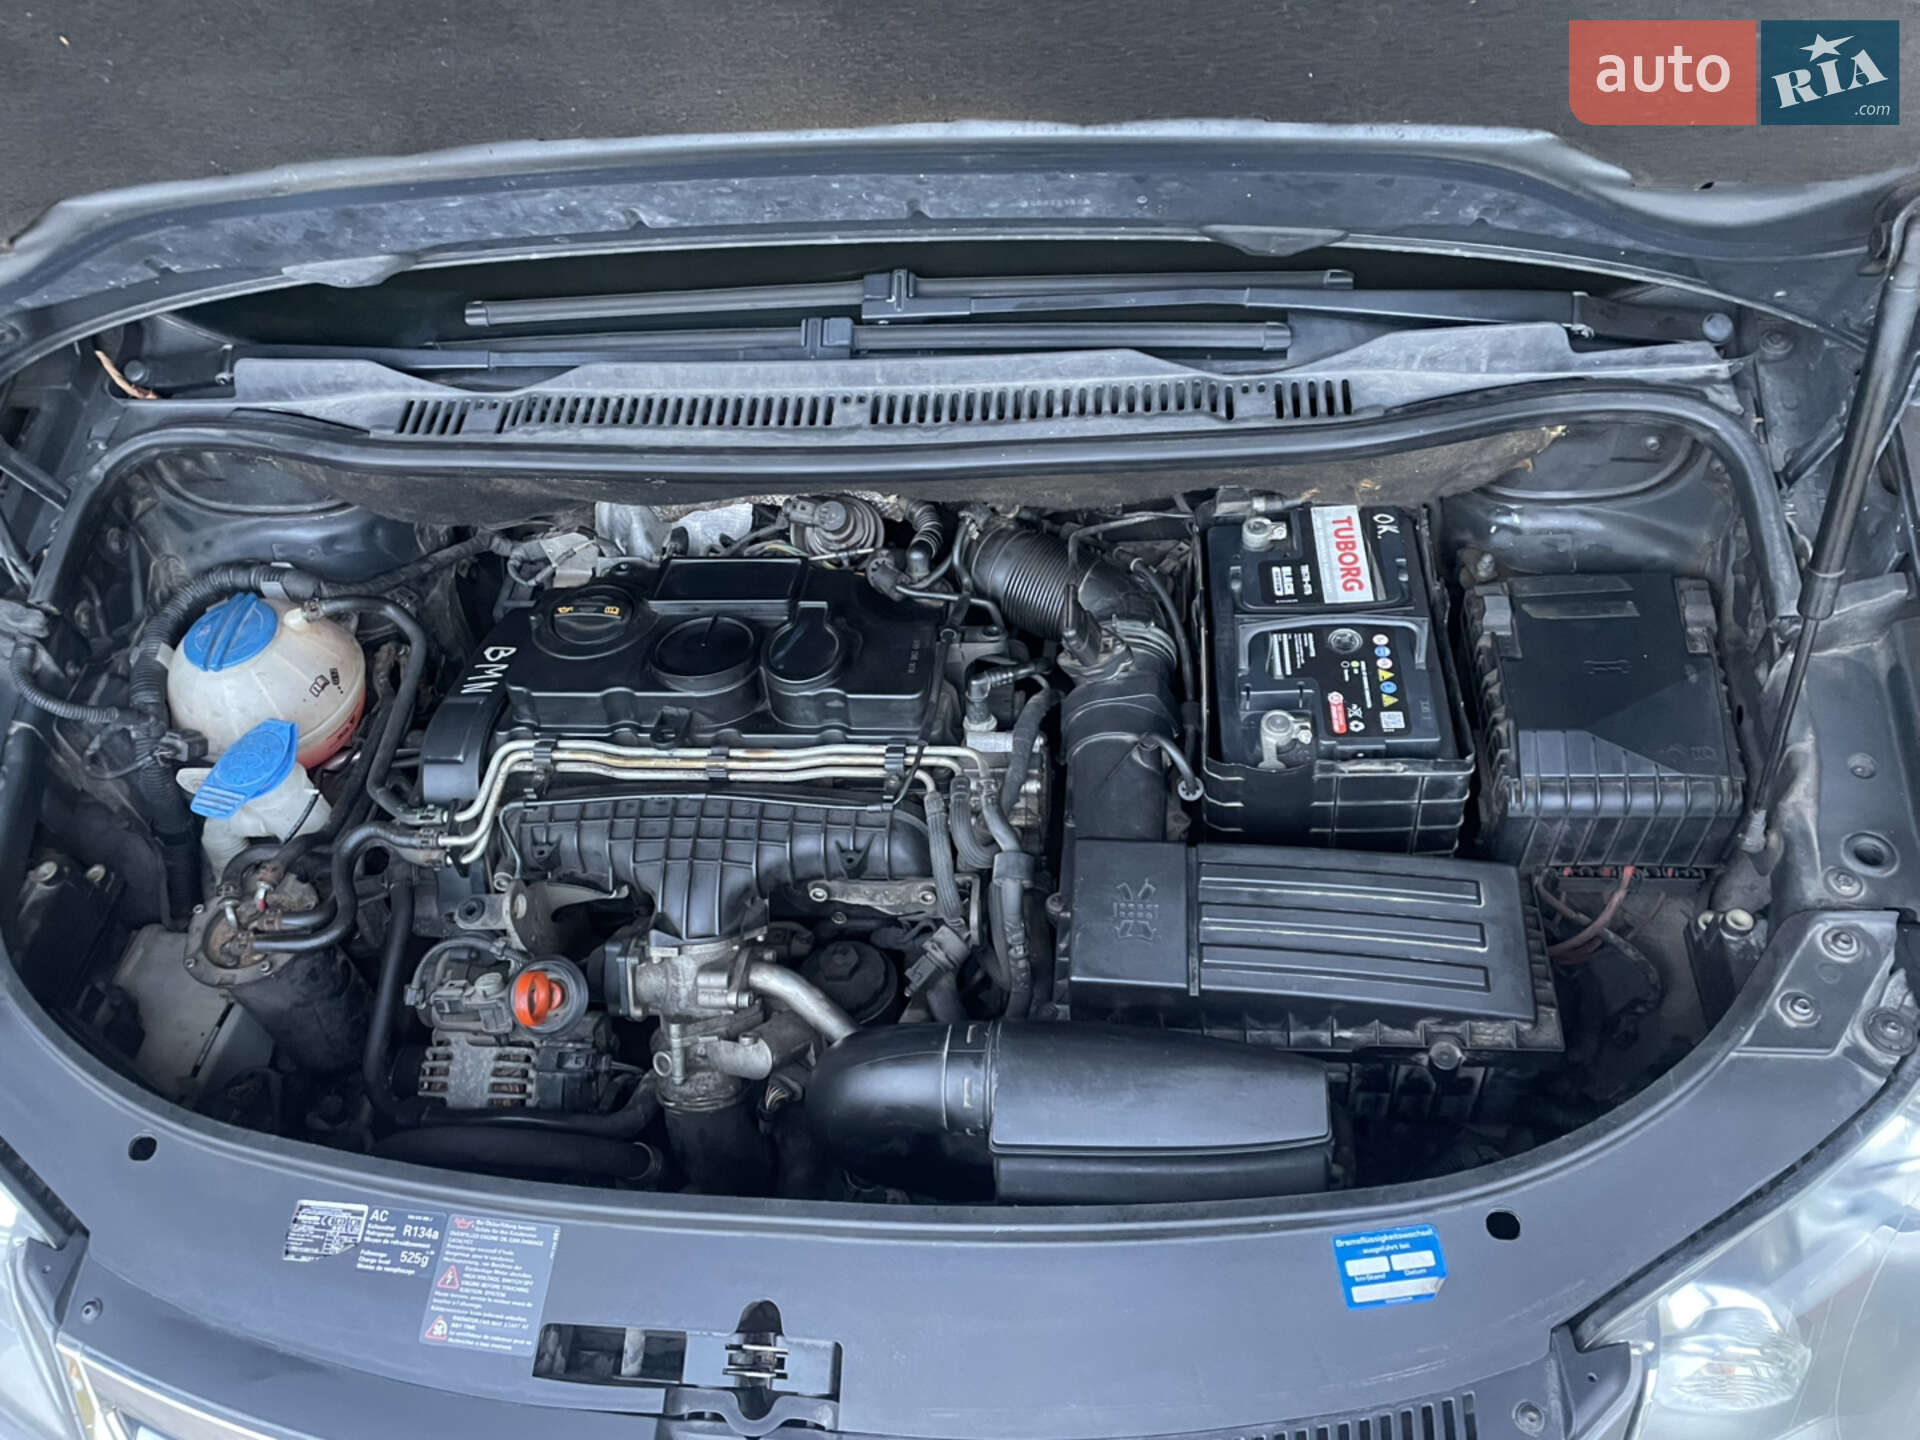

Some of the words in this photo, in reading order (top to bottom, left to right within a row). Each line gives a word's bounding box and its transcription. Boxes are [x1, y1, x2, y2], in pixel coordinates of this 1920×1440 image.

[1331, 516, 1364, 592] TUBORG
[461, 646, 517, 695] BMN
[369, 1208, 389, 1222] AC
[402, 1224, 440, 1240] R134a
[400, 1250, 430, 1268] 525g
